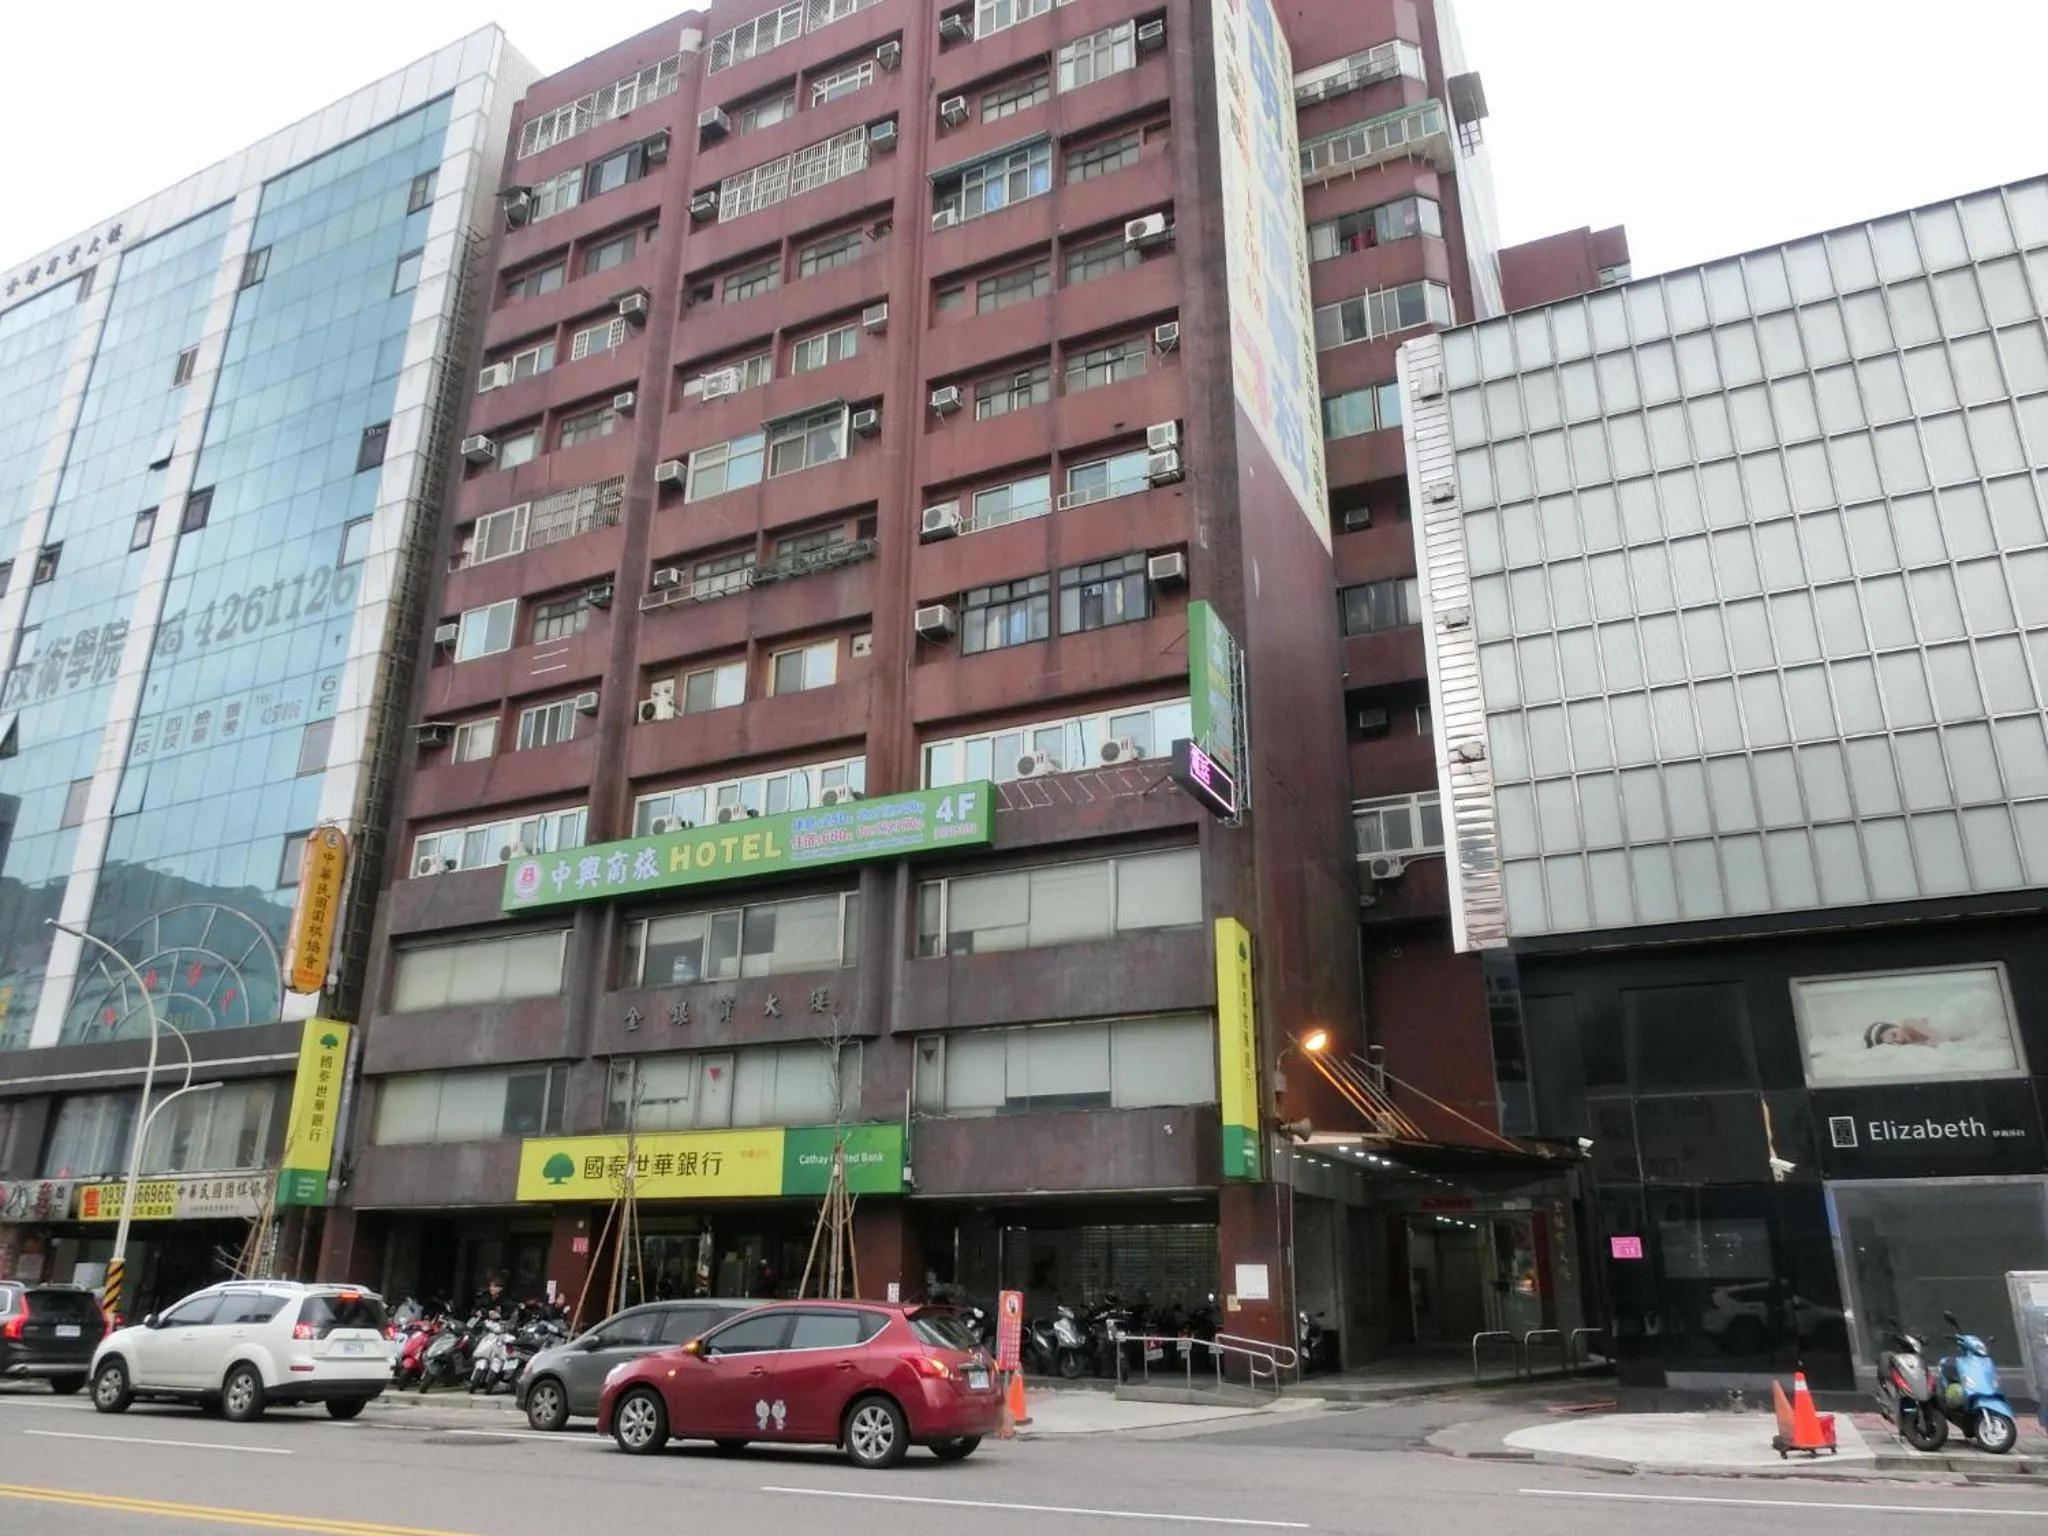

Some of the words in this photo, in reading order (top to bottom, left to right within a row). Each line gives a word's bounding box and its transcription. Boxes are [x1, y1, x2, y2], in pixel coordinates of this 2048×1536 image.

[195, 564, 356, 646] 4261126
[936, 791, 976, 822] 4F
[551, 846, 660, 894] 中興商旅
[669, 831, 782, 873] HOTEL
[1869, 1116, 1987, 1141] Elizabeth
[583, 1151, 723, 1180] 國泰世華銀行
[799, 1152, 829, 1165] Cathay
[861, 1151, 884, 1163] Bank
